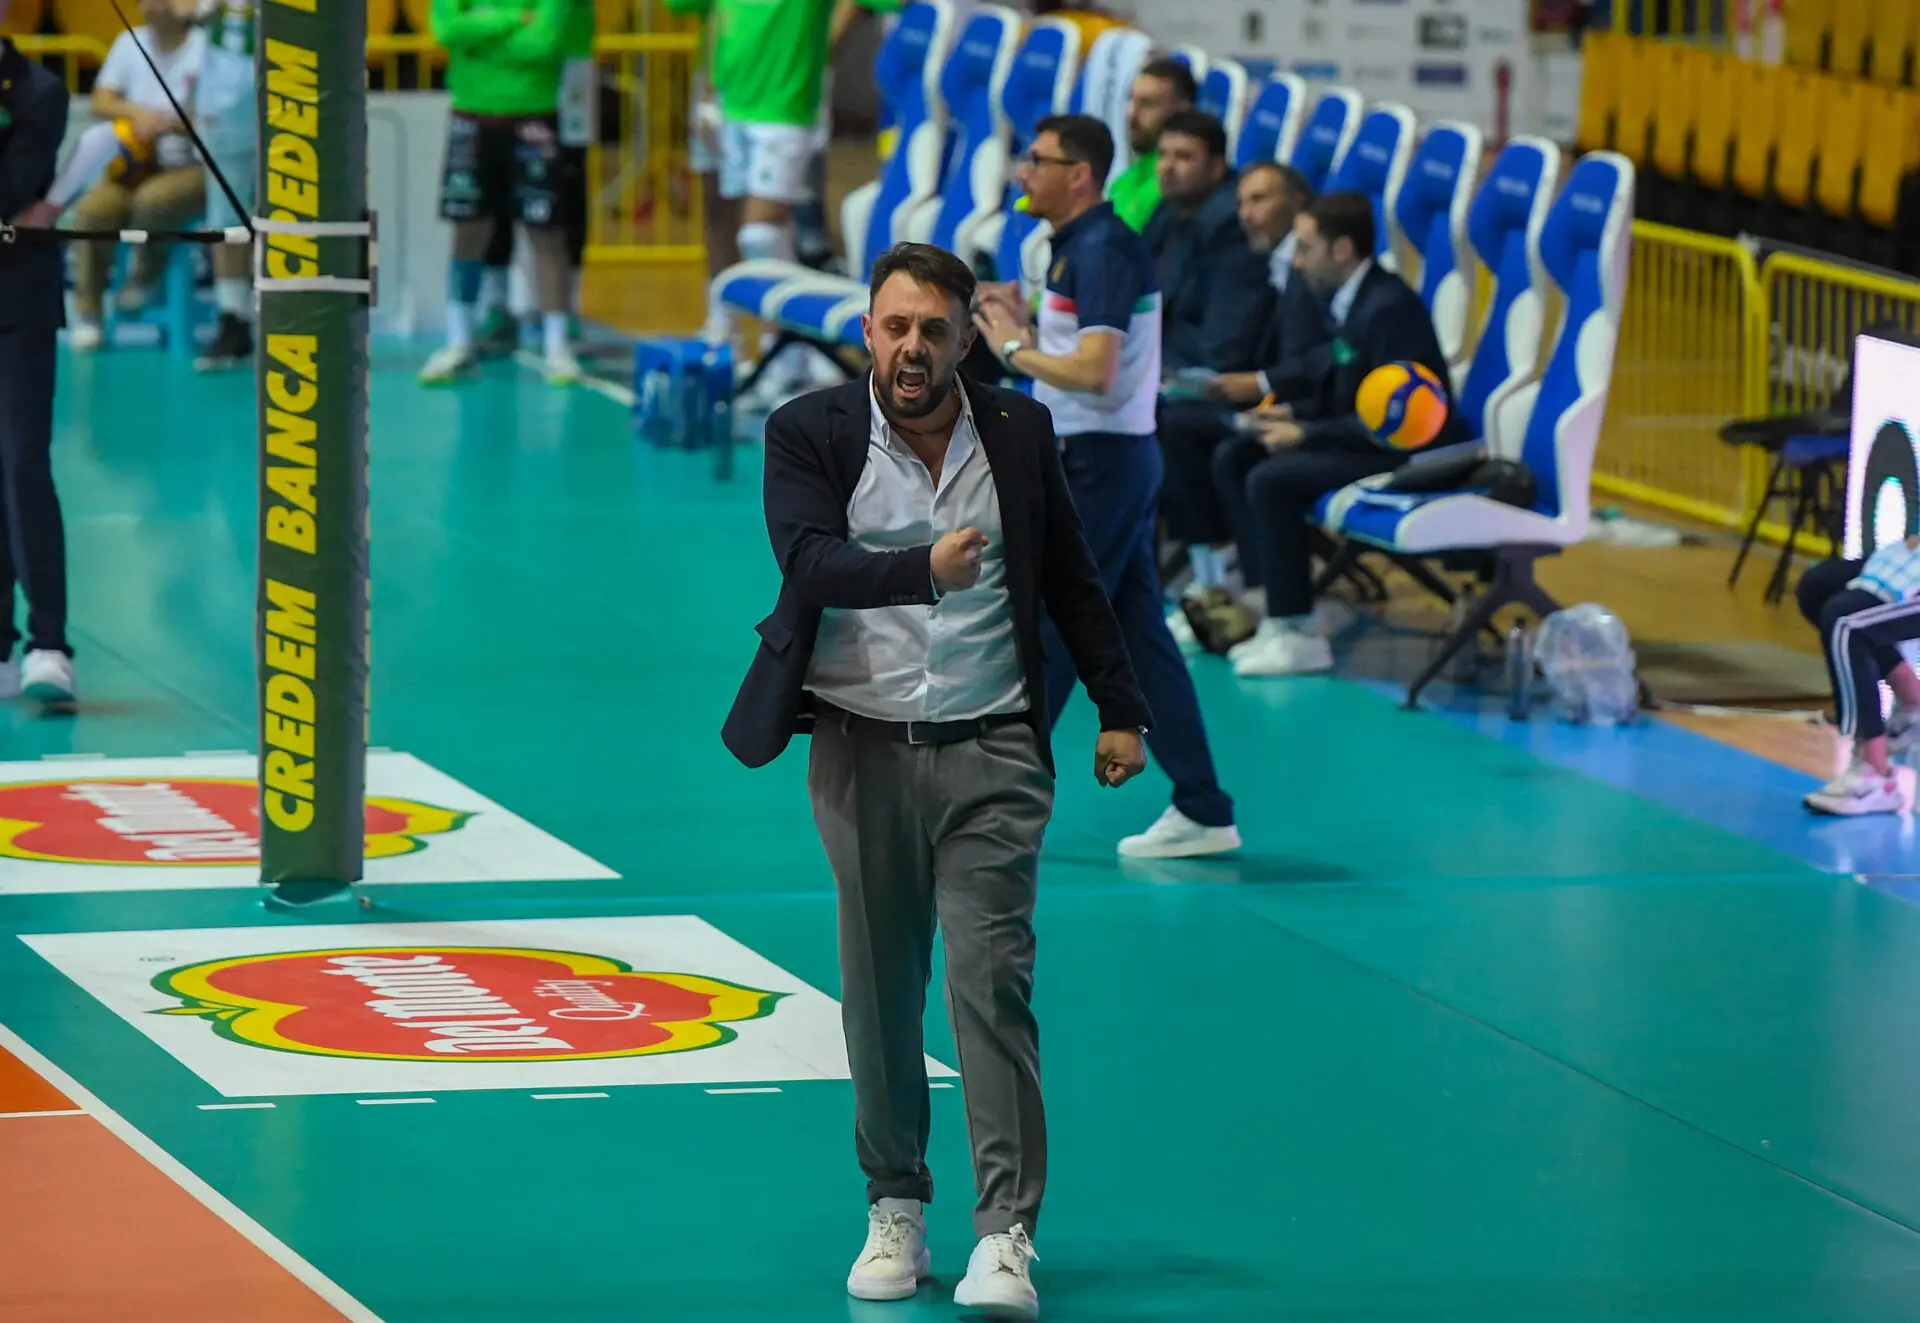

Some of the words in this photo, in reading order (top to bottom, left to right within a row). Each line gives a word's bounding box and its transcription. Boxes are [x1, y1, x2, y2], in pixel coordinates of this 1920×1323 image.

[265, 333, 318, 555] BANCA
[263, 578, 317, 832] CREDEM
[319, 955, 521, 1018] Monte
[532, 979, 652, 1020] Quality
[391, 1017, 575, 1053] Del
